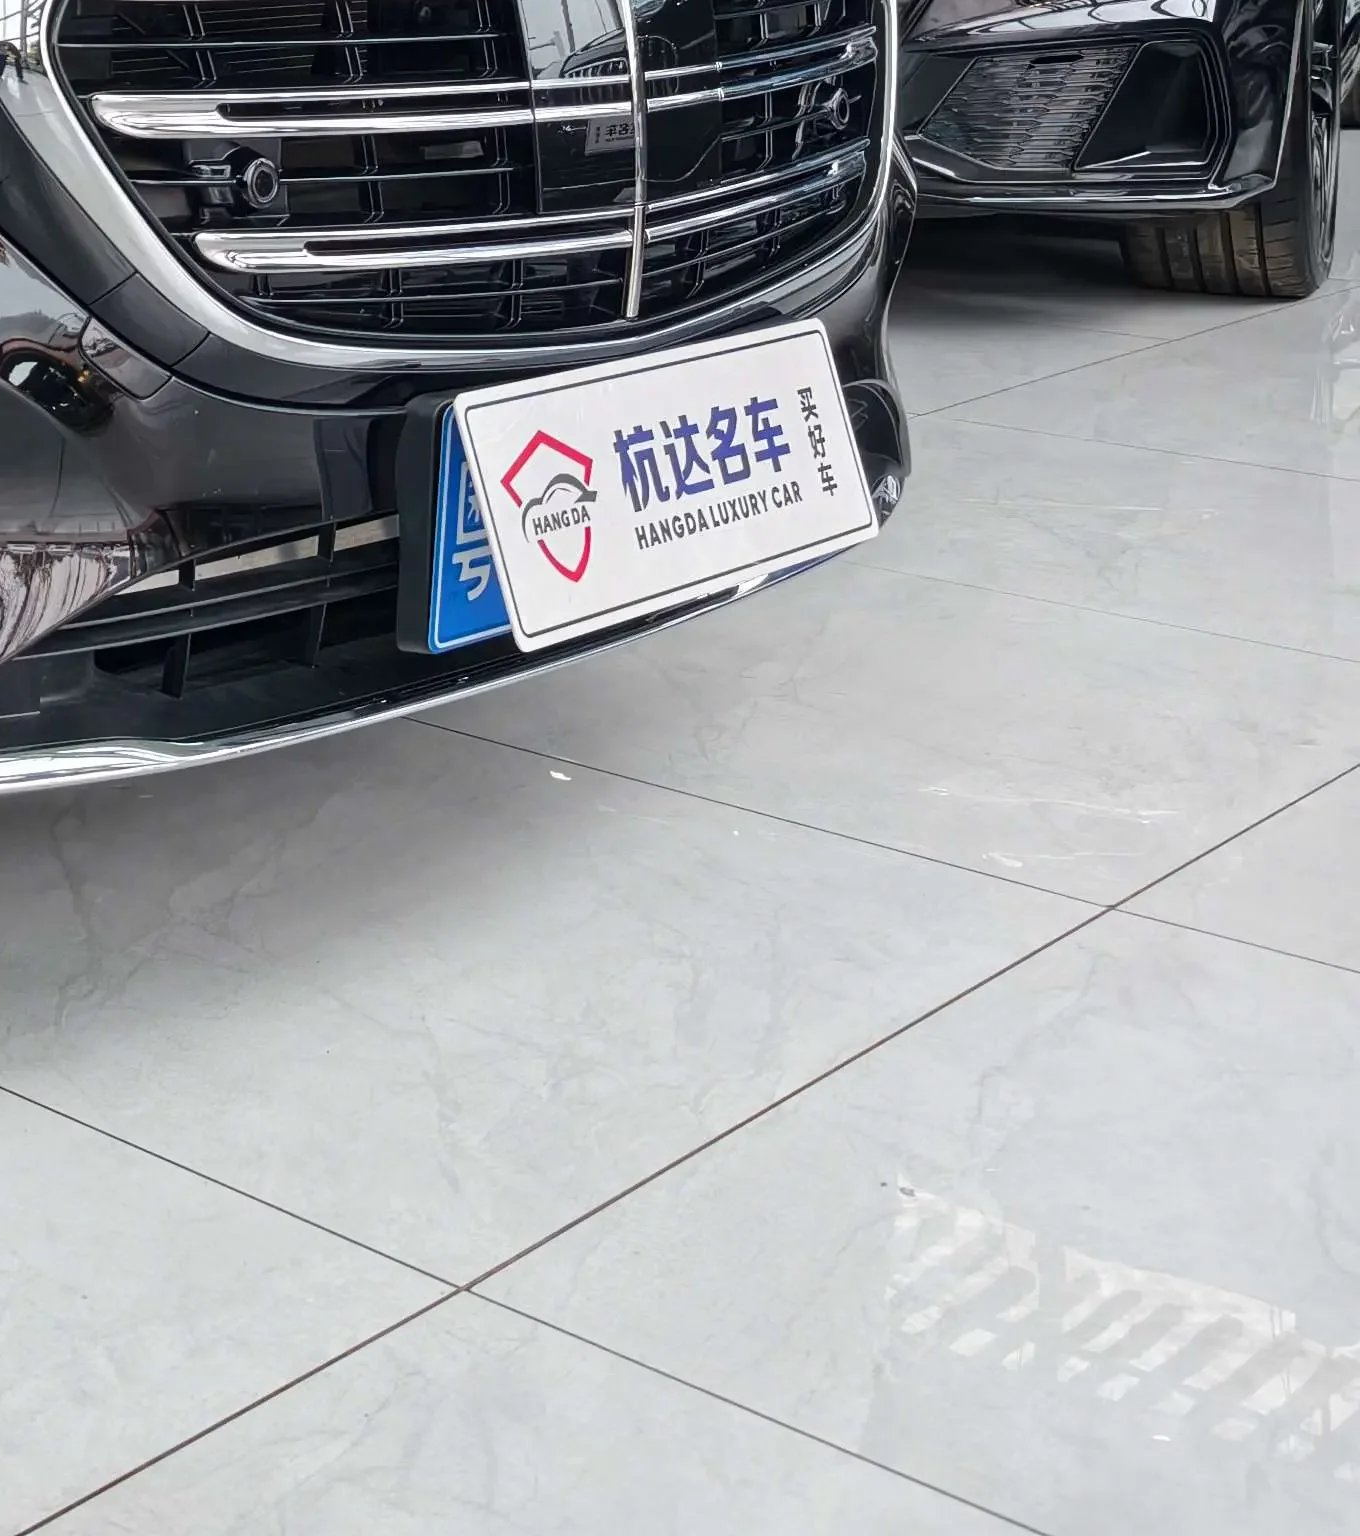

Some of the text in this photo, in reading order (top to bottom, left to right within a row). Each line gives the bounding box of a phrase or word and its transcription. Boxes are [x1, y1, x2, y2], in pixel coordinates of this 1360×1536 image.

[613, 396, 791, 513] 杭达名车
[797, 386, 838, 497] 买好车
[532, 504, 592, 537] HANG DA
[771, 480, 804, 509] CAR
